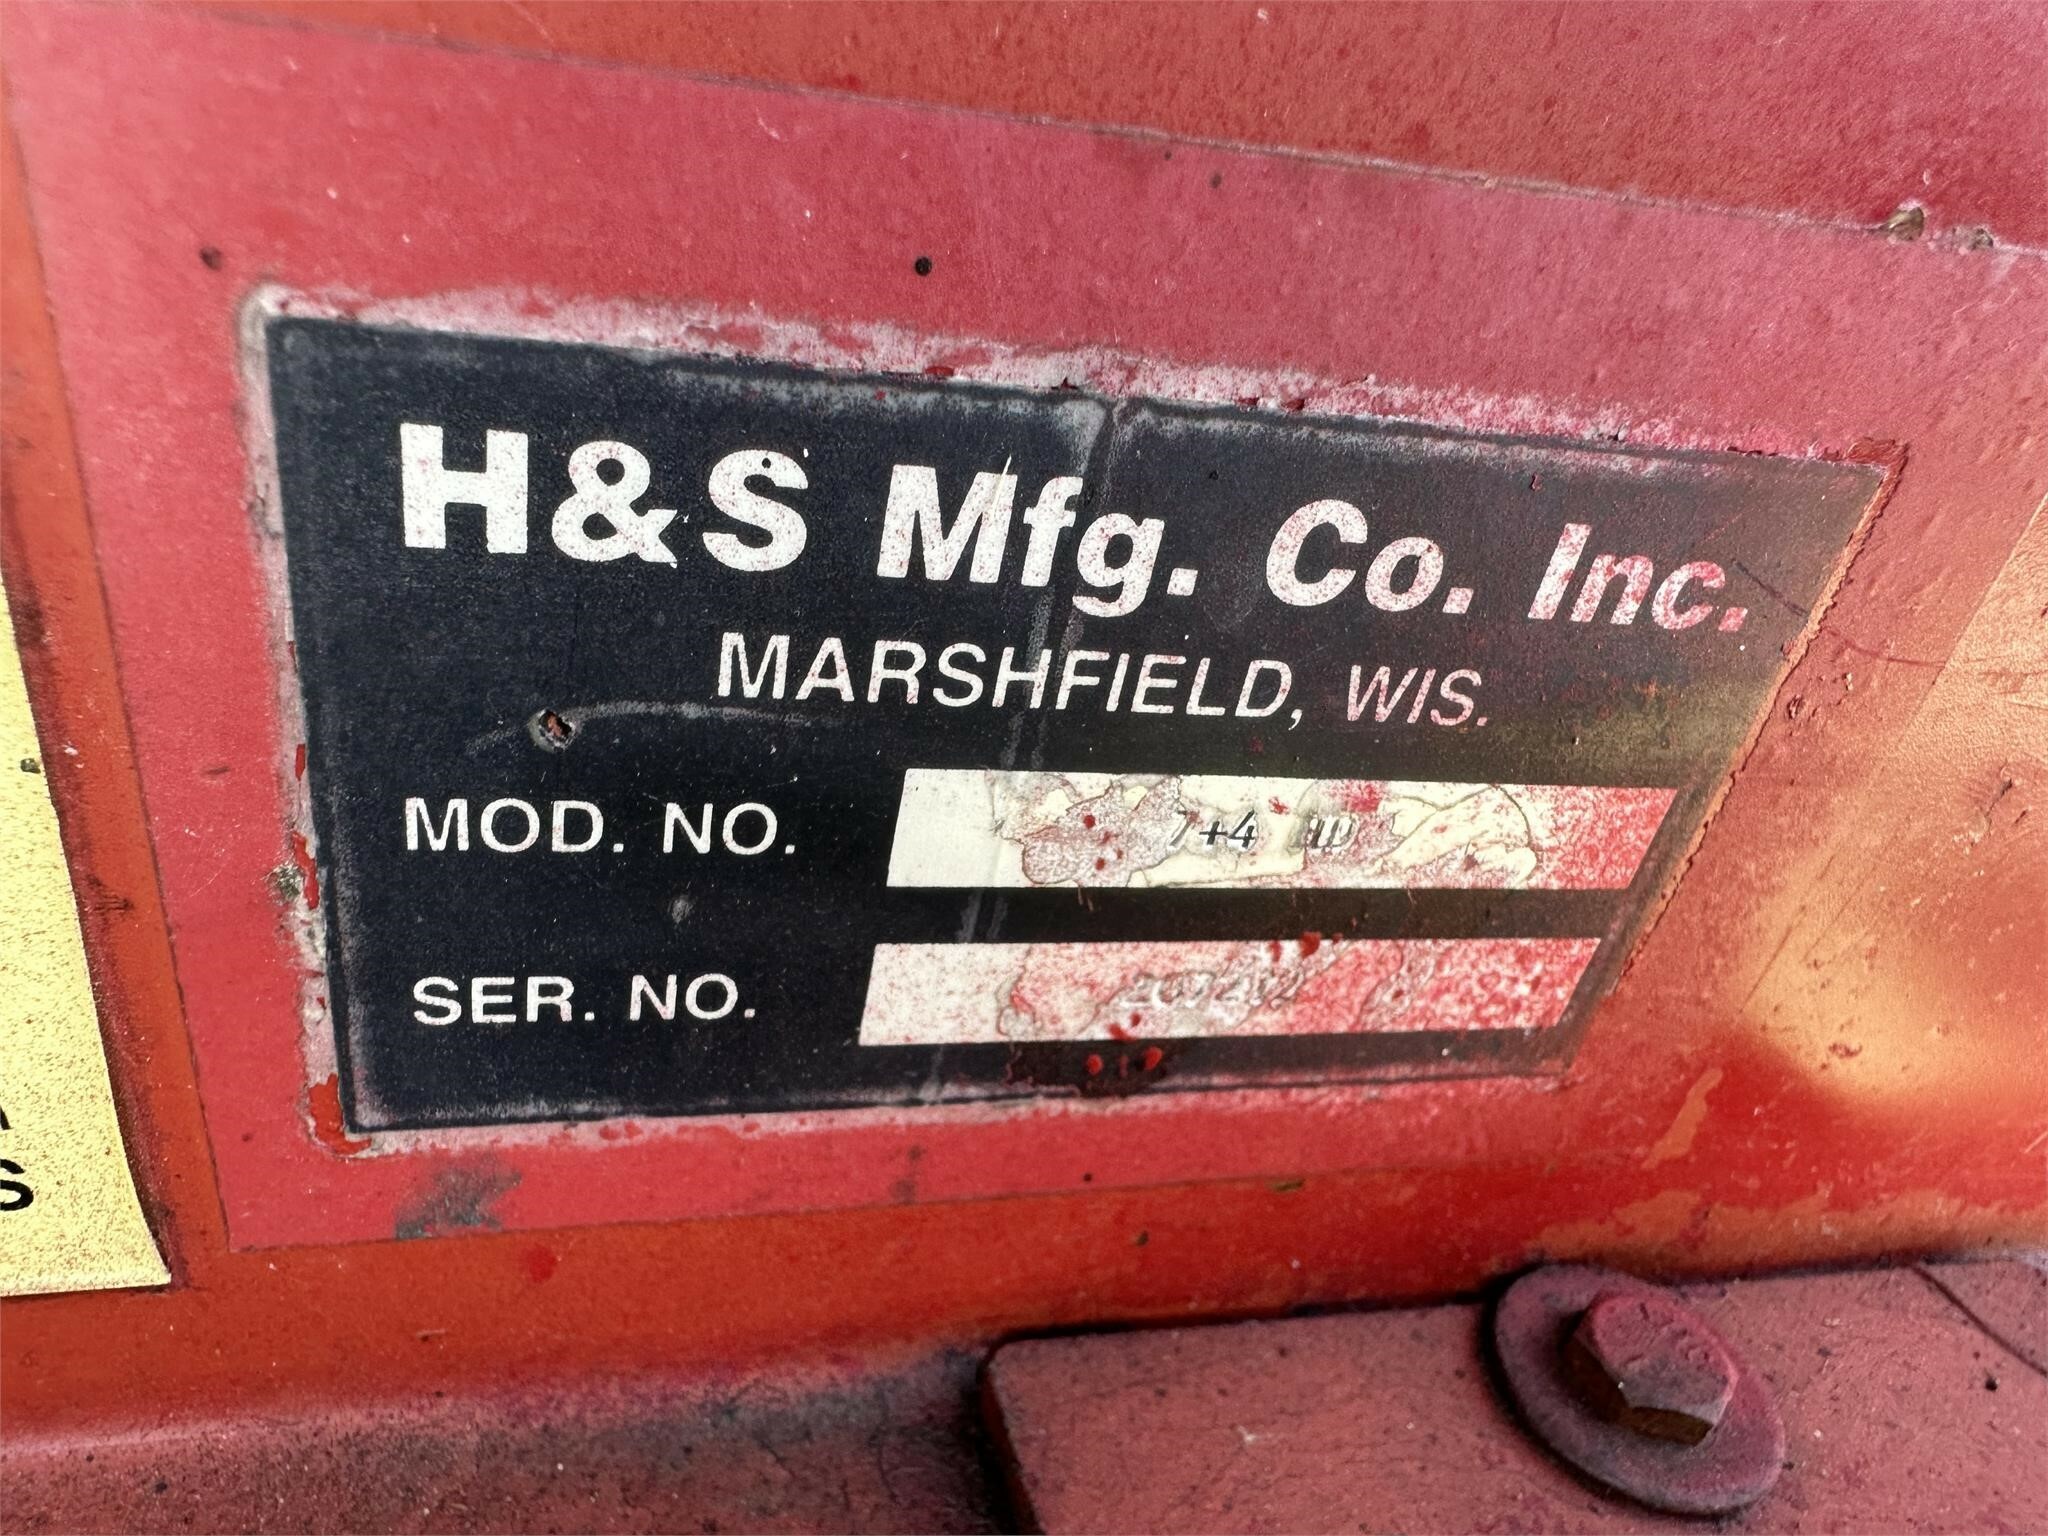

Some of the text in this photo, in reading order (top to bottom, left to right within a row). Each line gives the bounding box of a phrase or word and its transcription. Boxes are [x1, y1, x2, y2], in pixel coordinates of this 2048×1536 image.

[400, 423, 1749, 633] H&S Mfg. Co. Inc.
[717, 632, 1489, 731] MARSHFIELD, WIS.
[404, 797, 625, 854] MOD.
[662, 801, 796, 855] NO.
[412, 975, 596, 1026] SER.
[628, 972, 757, 1021] NO.
